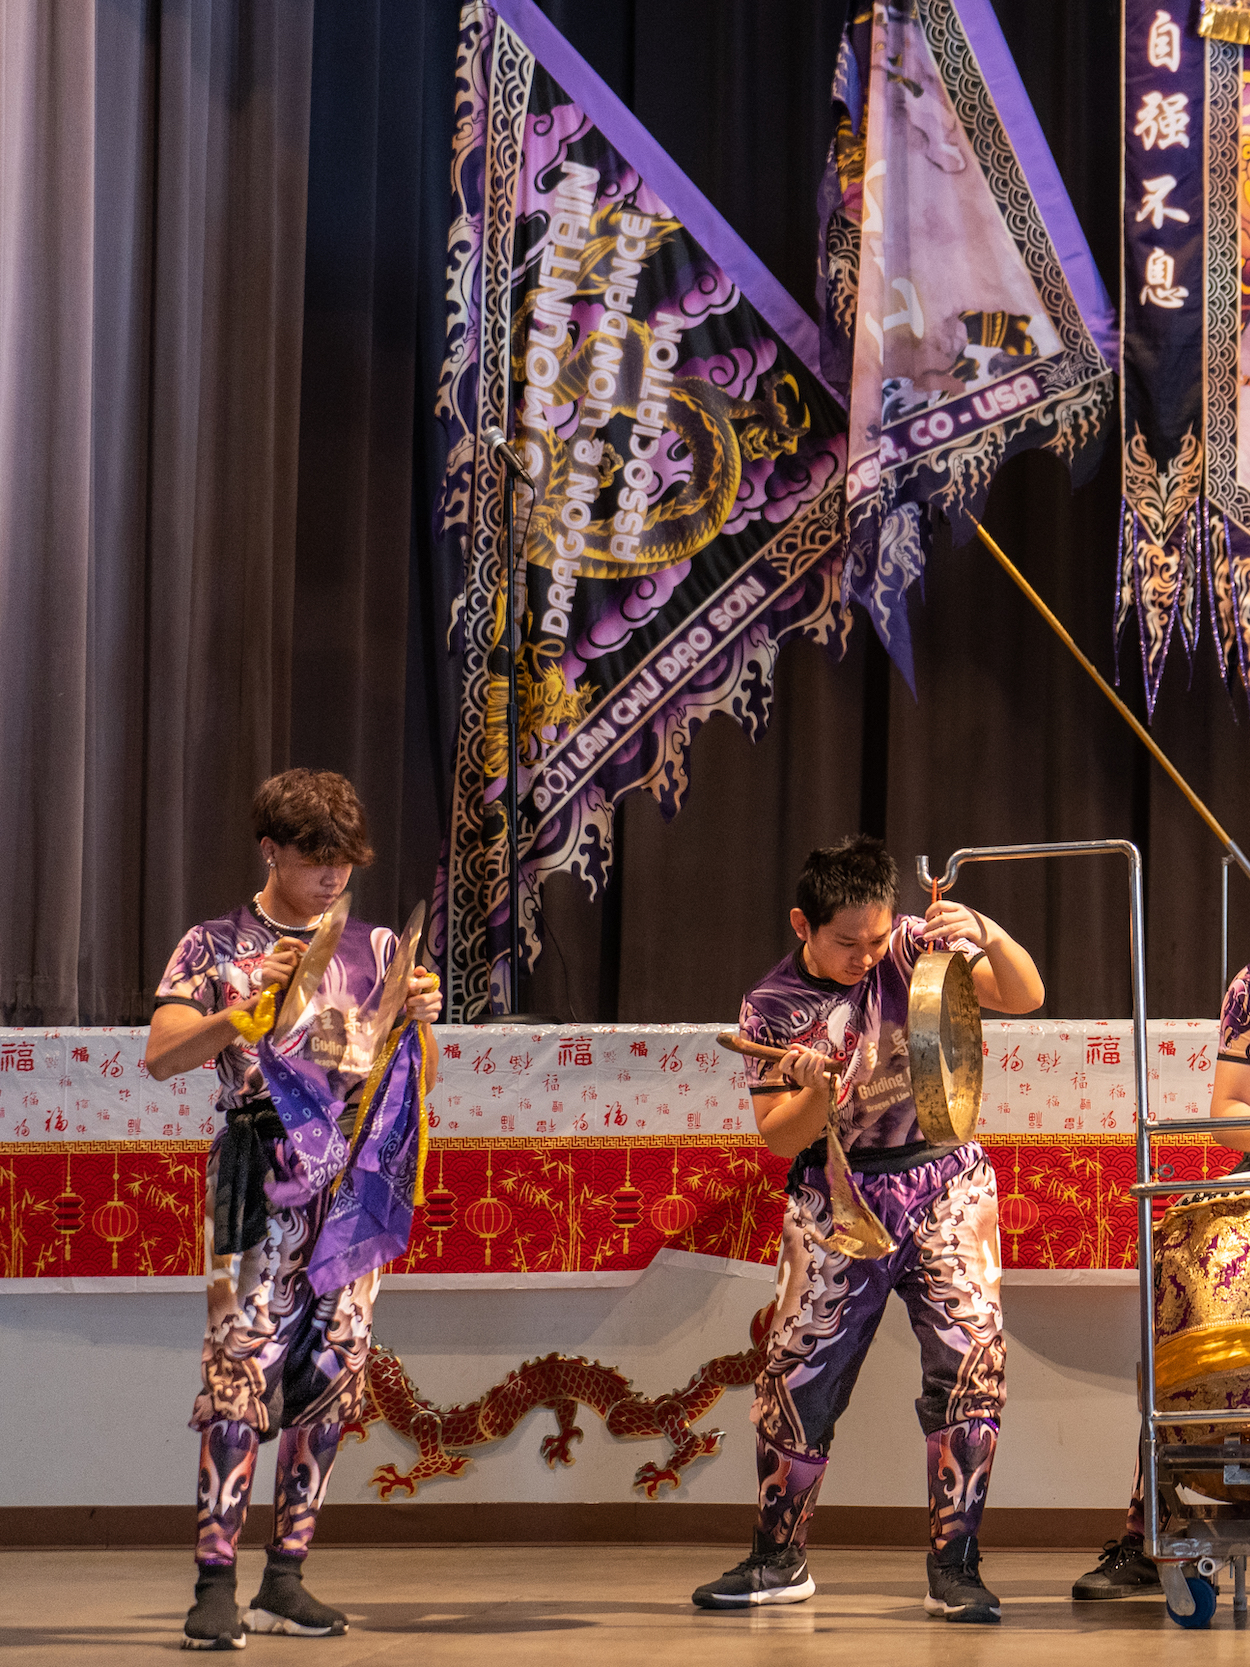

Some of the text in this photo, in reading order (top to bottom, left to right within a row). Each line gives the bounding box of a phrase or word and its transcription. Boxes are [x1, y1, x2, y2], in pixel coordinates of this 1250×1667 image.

[1135, 11, 1191, 310] 自强不息
[523, 161, 600, 431] MOUNTAIN
[910, 412, 954, 447] CO
[972, 375, 1040, 421] USA
[541, 213, 653, 638] DRAGON & LION DANCE
[611, 313, 685, 561] ASSOCIATION
[0, 1041, 35, 1072] 福
[72, 1046, 90, 1062] 福
[444, 1044, 461, 1059] 福
[558, 1036, 593, 1066] 福
[630, 1041, 648, 1057] 福
[1086, 1034, 1121, 1065] 福
[1158, 1040, 1176, 1056] 福
[170, 1078, 186, 1095] 福
[543, 1074, 560, 1092] 福
[858, 1073, 906, 1100] Guiding
[1070, 1072, 1088, 1090] 福
